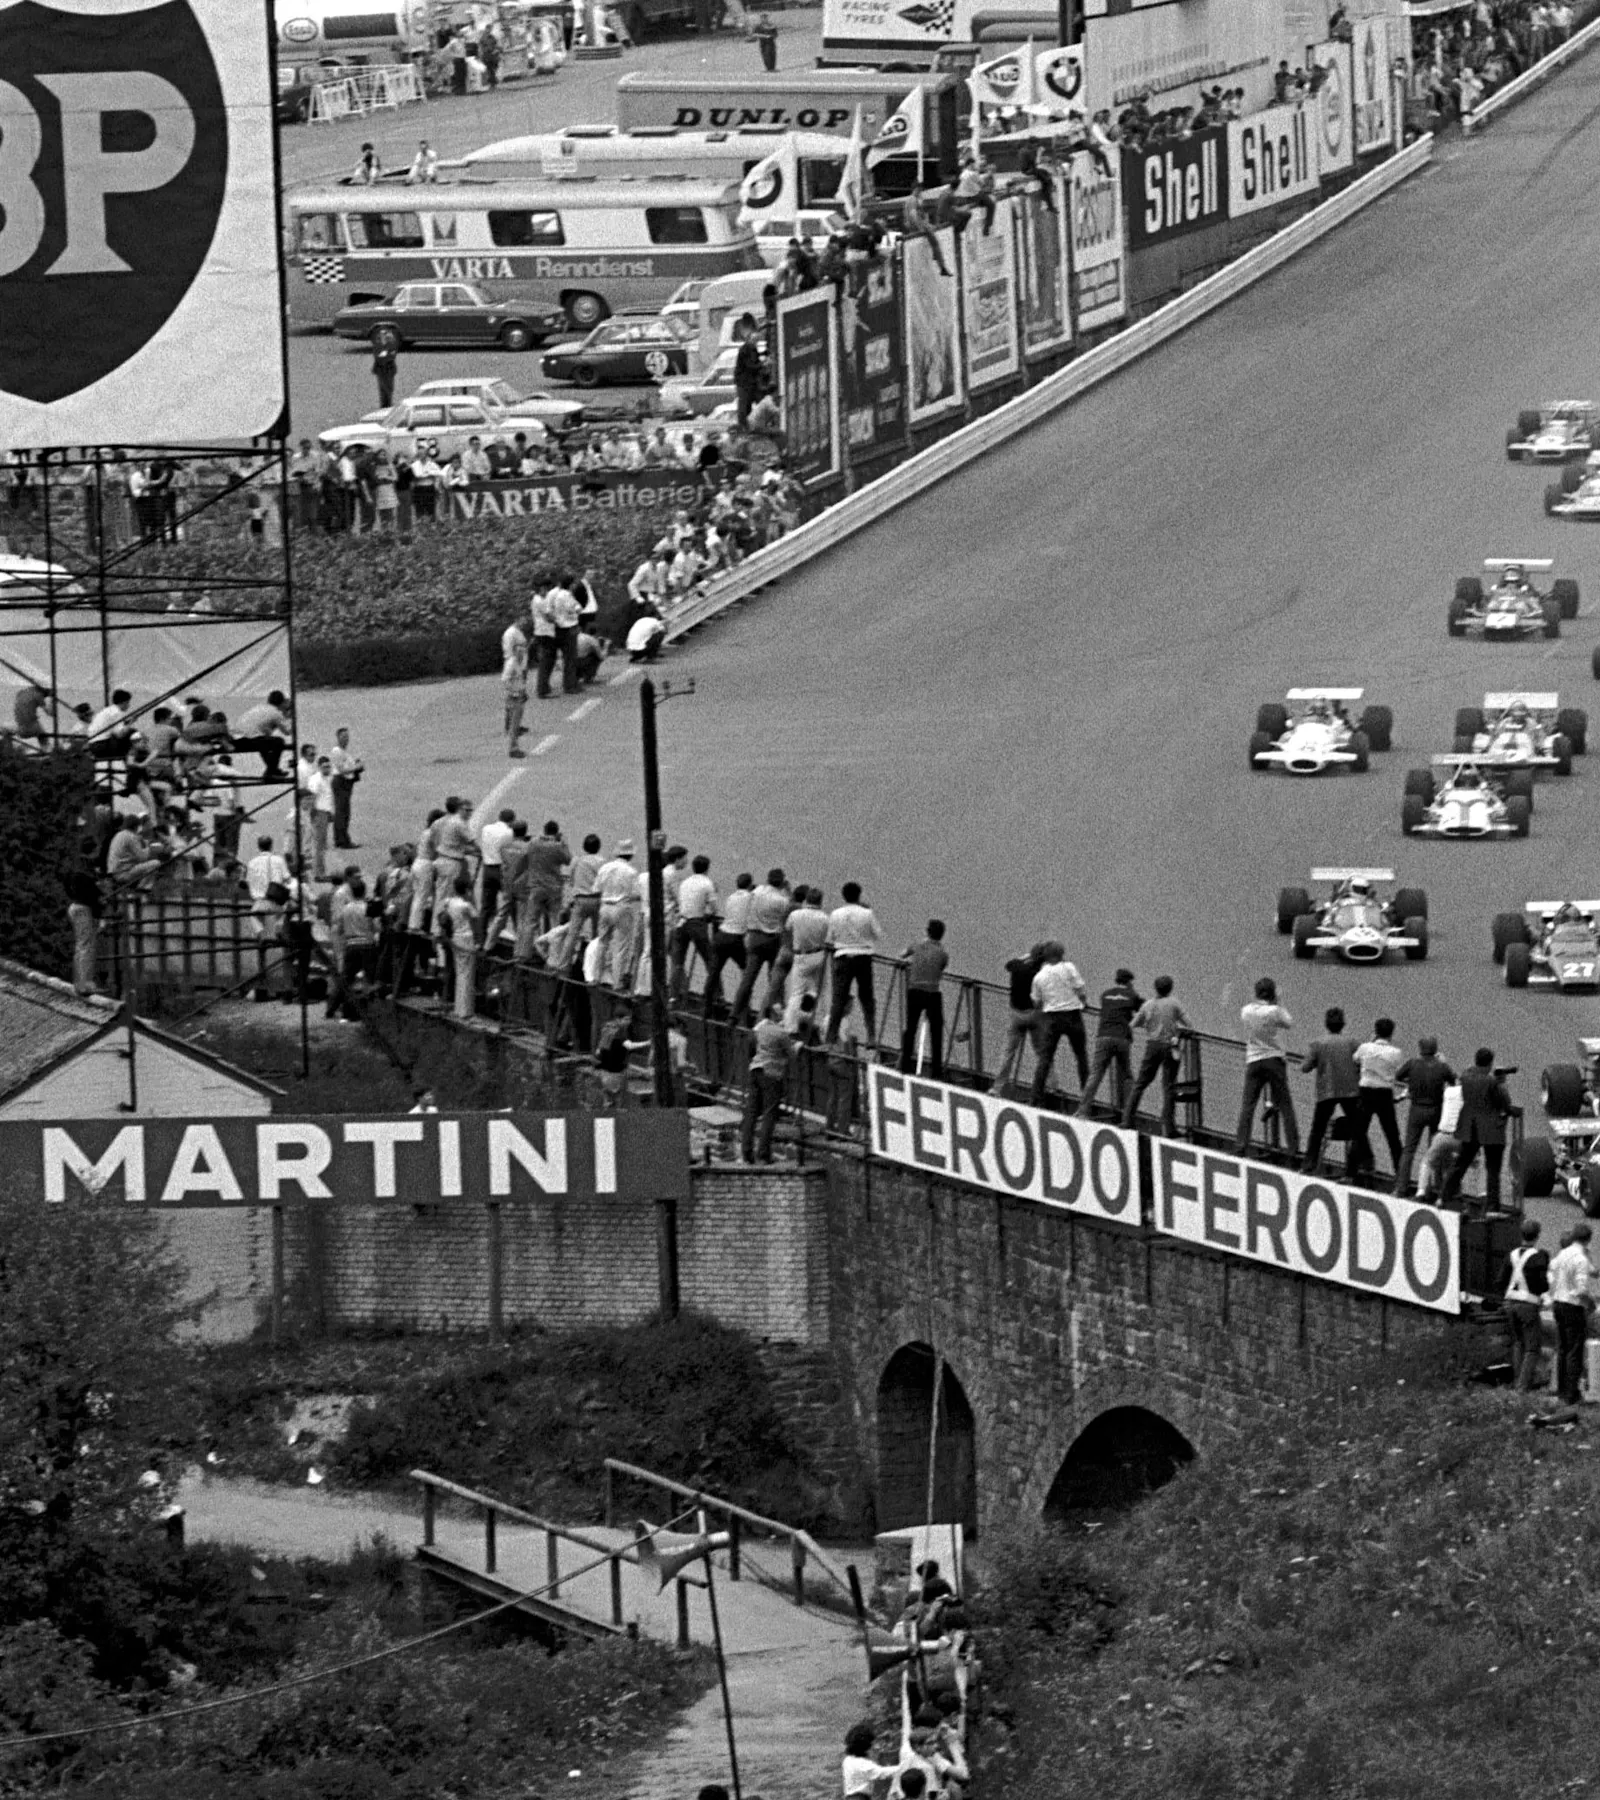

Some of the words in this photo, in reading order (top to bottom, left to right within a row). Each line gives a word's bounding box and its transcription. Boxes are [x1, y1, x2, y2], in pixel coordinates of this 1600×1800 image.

[842, 1, 891, 12] RACING
[845, 13, 886, 24] TYRES
[672, 107, 850, 127] DUNLOP
[0, 70, 196, 277] P
[1242, 111, 1307, 200] Shell
[1145, 138, 1218, 234] Shell
[431, 257, 515, 279] VARTA
[535, 256, 655, 278] Renndienst
[455, 486, 568, 519] VARTA
[1562, 962, 1594, 977] 27
[42, 1117, 617, 1202] MARTINI
[873, 1073, 1130, 1216] FERODO
[1160, 1143, 1450, 1302] FERODO
